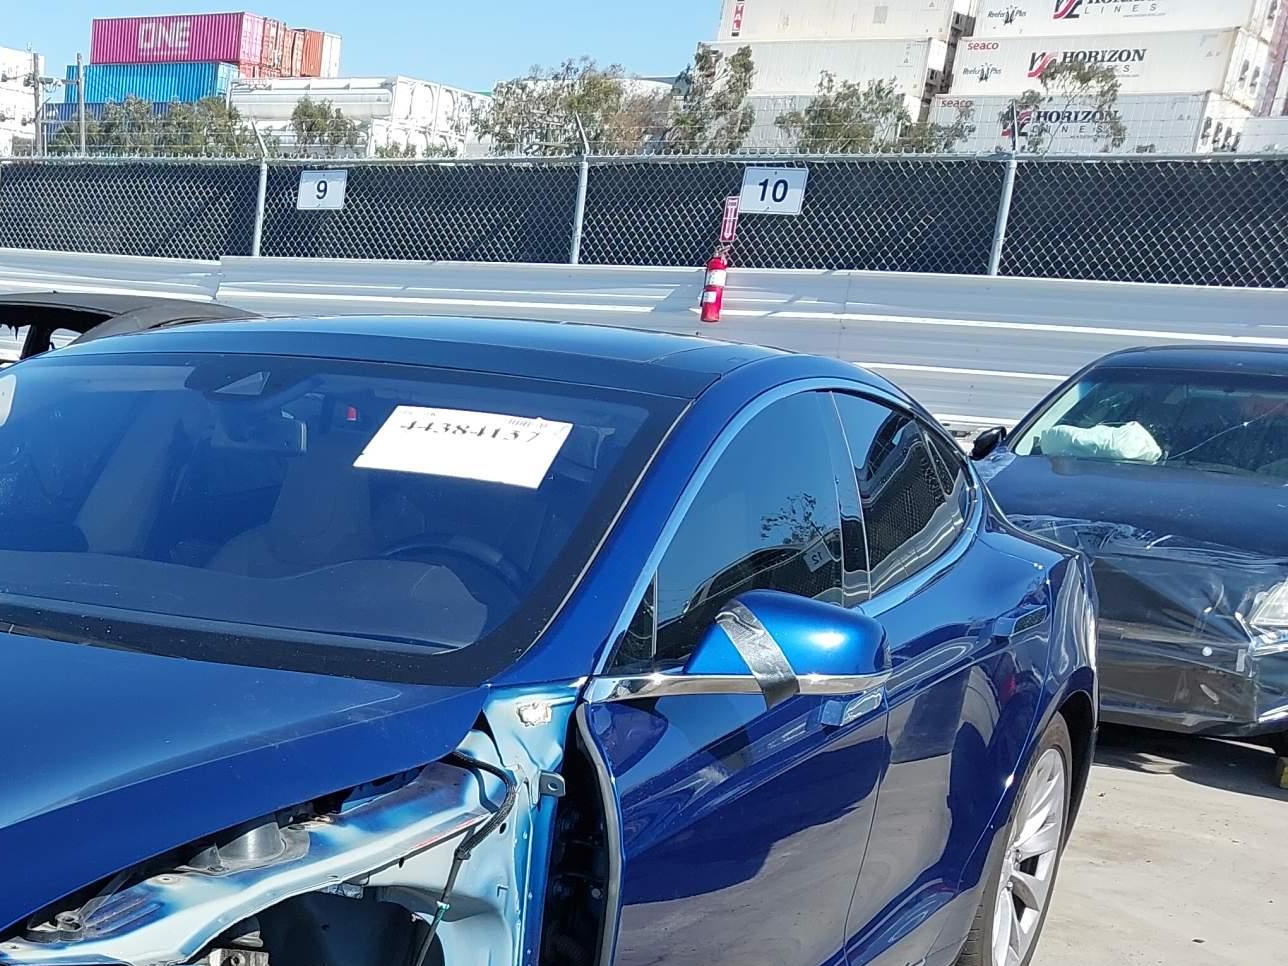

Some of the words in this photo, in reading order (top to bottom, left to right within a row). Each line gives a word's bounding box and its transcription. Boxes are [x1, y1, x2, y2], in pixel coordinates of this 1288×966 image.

[1084, 3, 1158, 15] LINES
[138, 21, 190, 49] ONE
[967, 42, 999, 51] seaco
[1061, 48, 1147, 64] HORIZON
[1035, 110, 1120, 124] HORIZON
[316, 180, 328, 200] 9
[757, 178, 789, 203] 10
